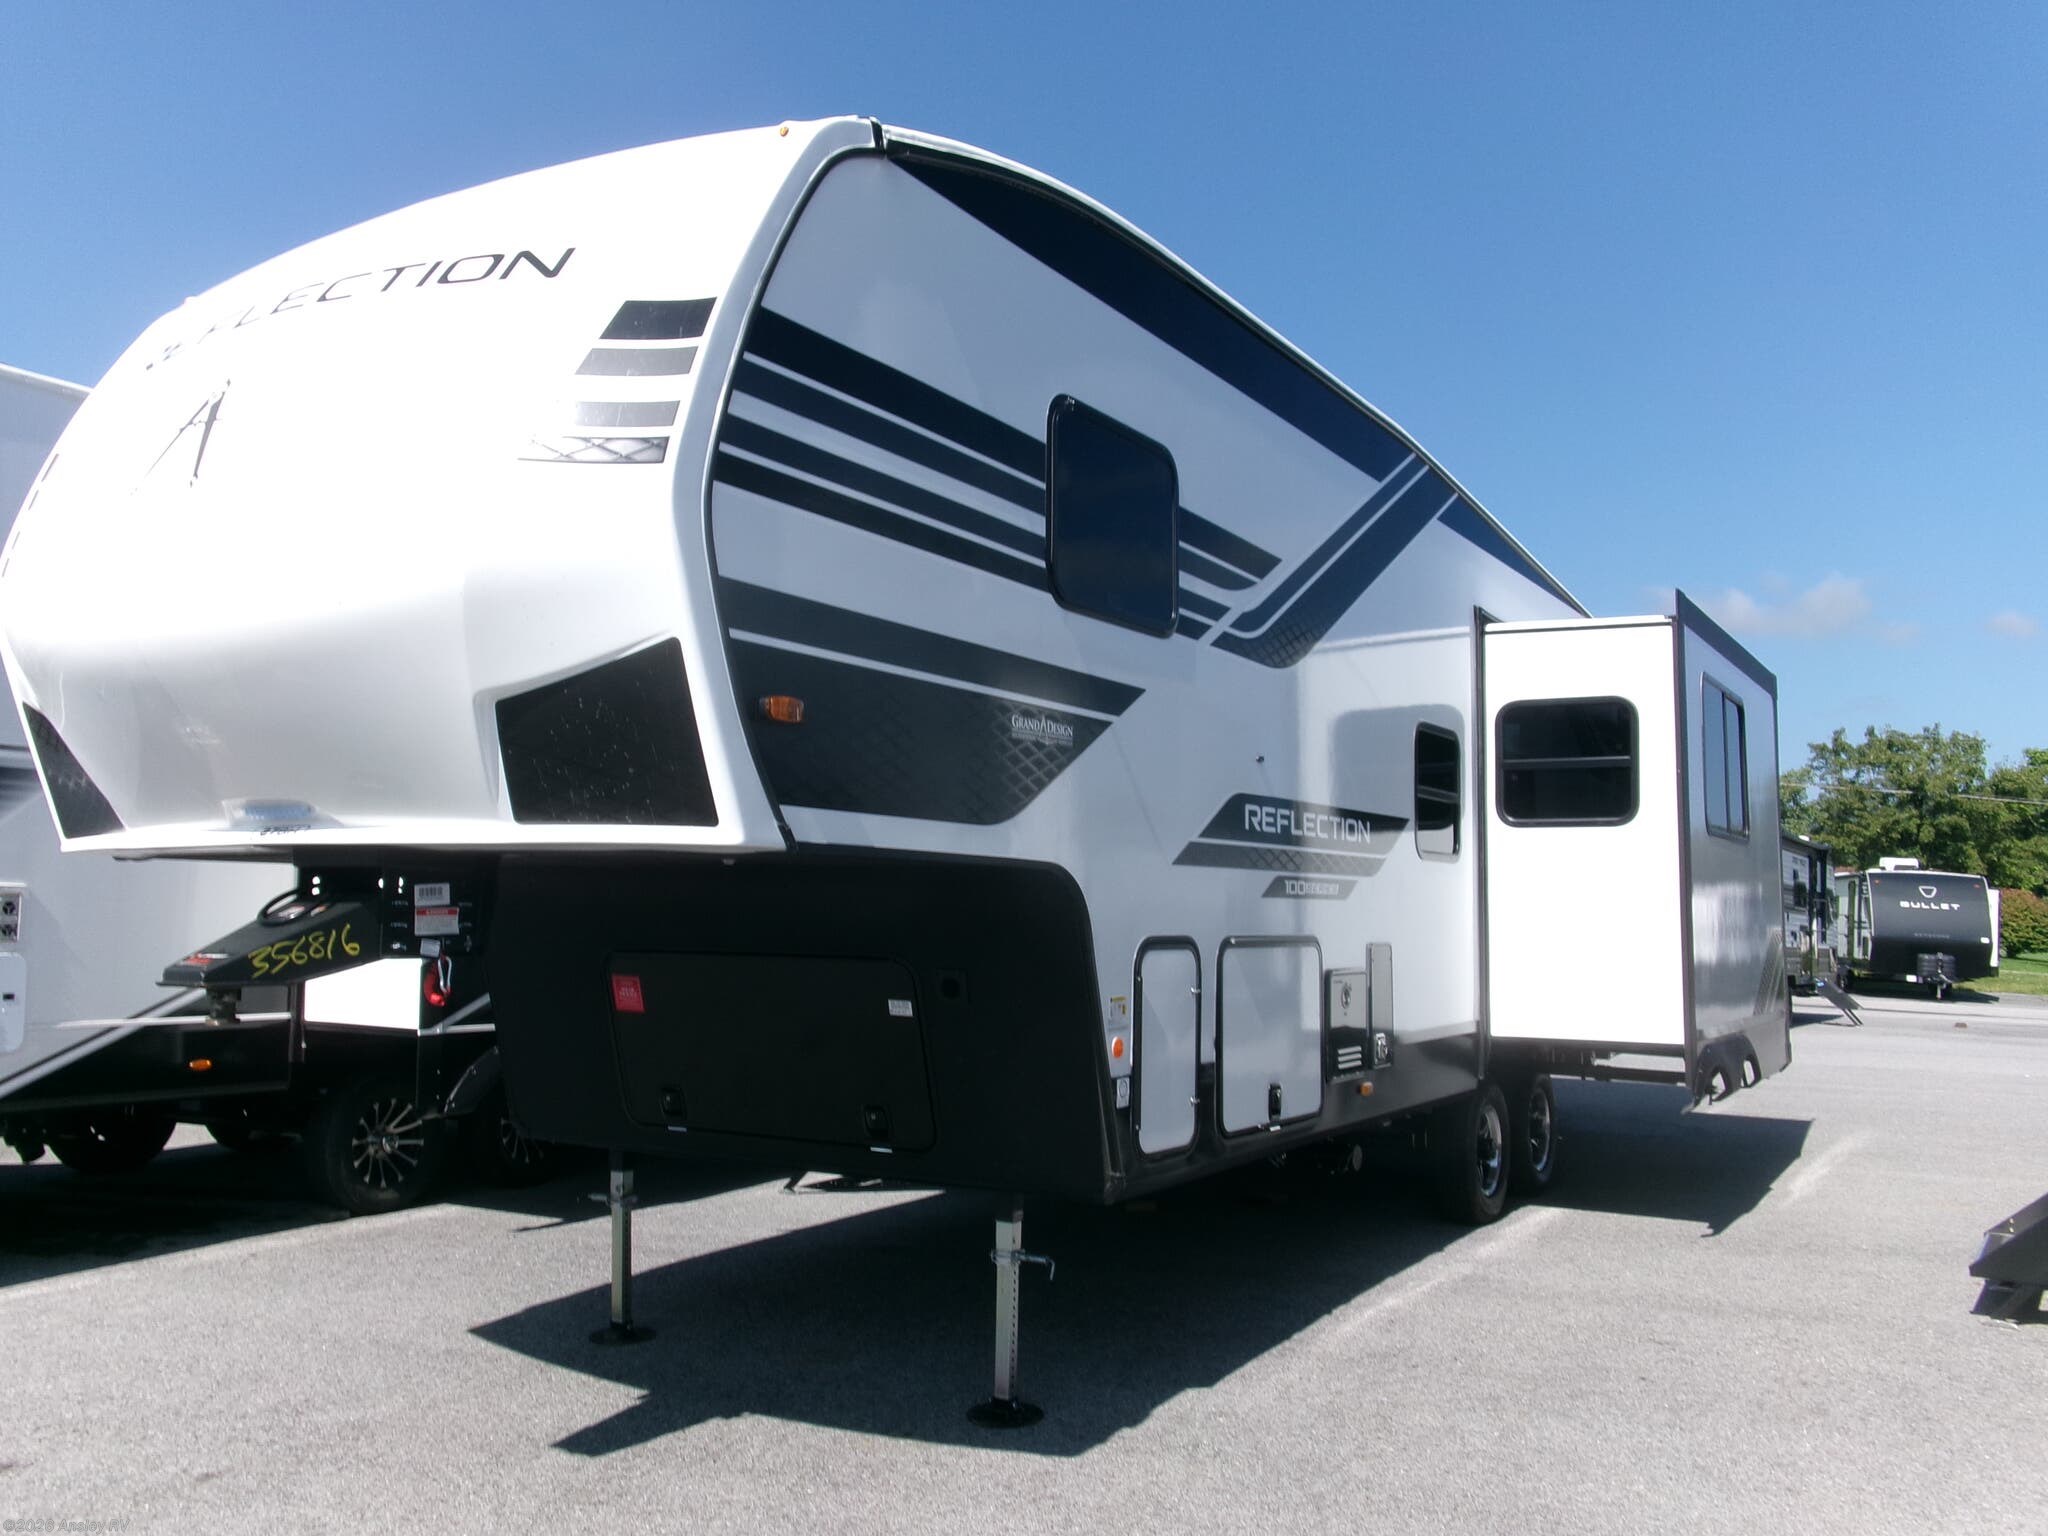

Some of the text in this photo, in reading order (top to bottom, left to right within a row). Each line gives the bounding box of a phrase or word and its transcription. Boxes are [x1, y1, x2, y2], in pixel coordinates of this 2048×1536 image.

[1244, 803, 1371, 843] REFLECTION
[1284, 879, 1306, 896] 100
[1899, 901, 1960, 910] BULLET
[248, 923, 361, 979] 356816
